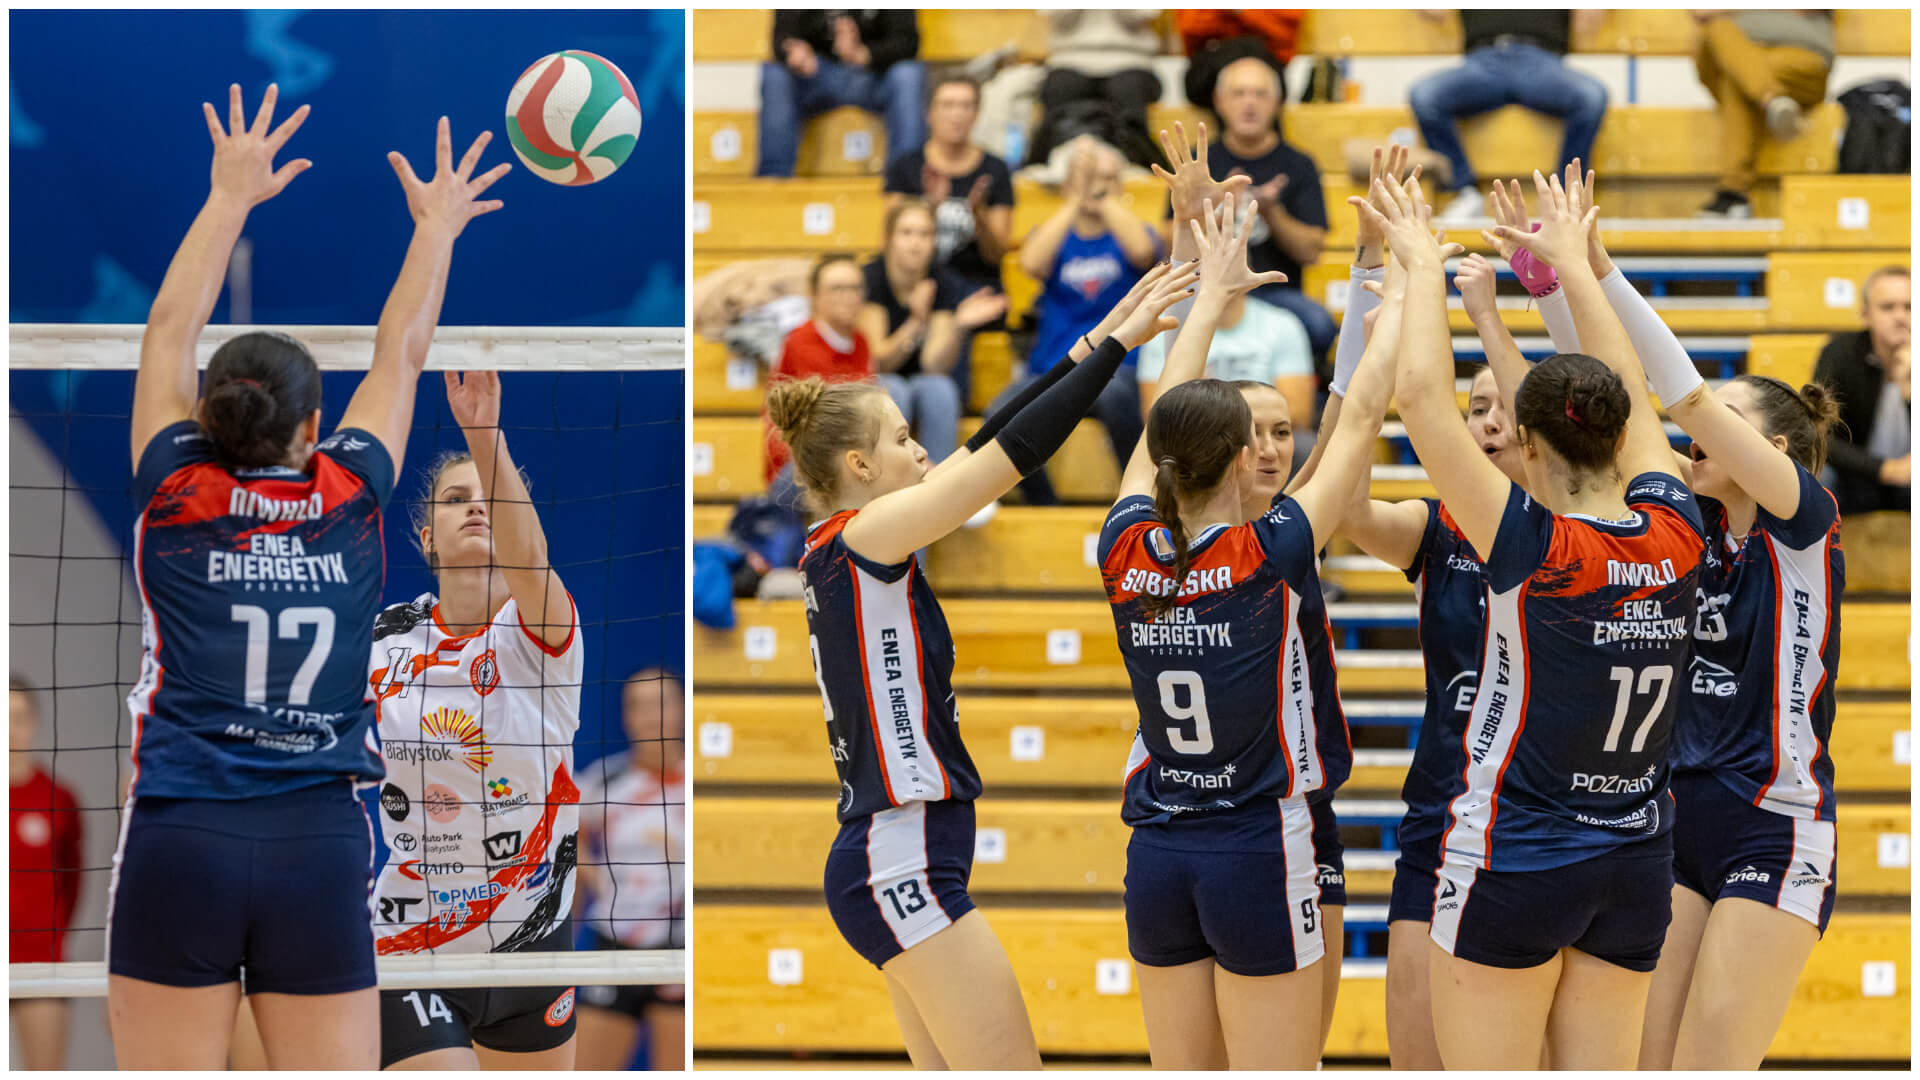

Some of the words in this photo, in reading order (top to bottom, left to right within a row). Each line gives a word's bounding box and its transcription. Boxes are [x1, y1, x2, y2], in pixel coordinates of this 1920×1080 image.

[251, 533, 305, 556] ENEA
[208, 550, 349, 584] ENERGETYK
[1623, 599, 1664, 621] ENEA
[231, 604, 336, 705] 17
[881, 628, 902, 682] ENEA
[1130, 622, 1233, 648] ENERGETYK
[378, 647, 414, 698] 14
[1495, 631, 1511, 686] ENEA
[889, 687, 918, 760] ENERGETYK
[1157, 670, 1214, 755] 9
[1603, 665, 1674, 753] 17
[443, 831, 463, 842] Park
[882, 878, 928, 921] 13
[1301, 898, 1315, 934] 9
[402, 990, 453, 1028] 14
